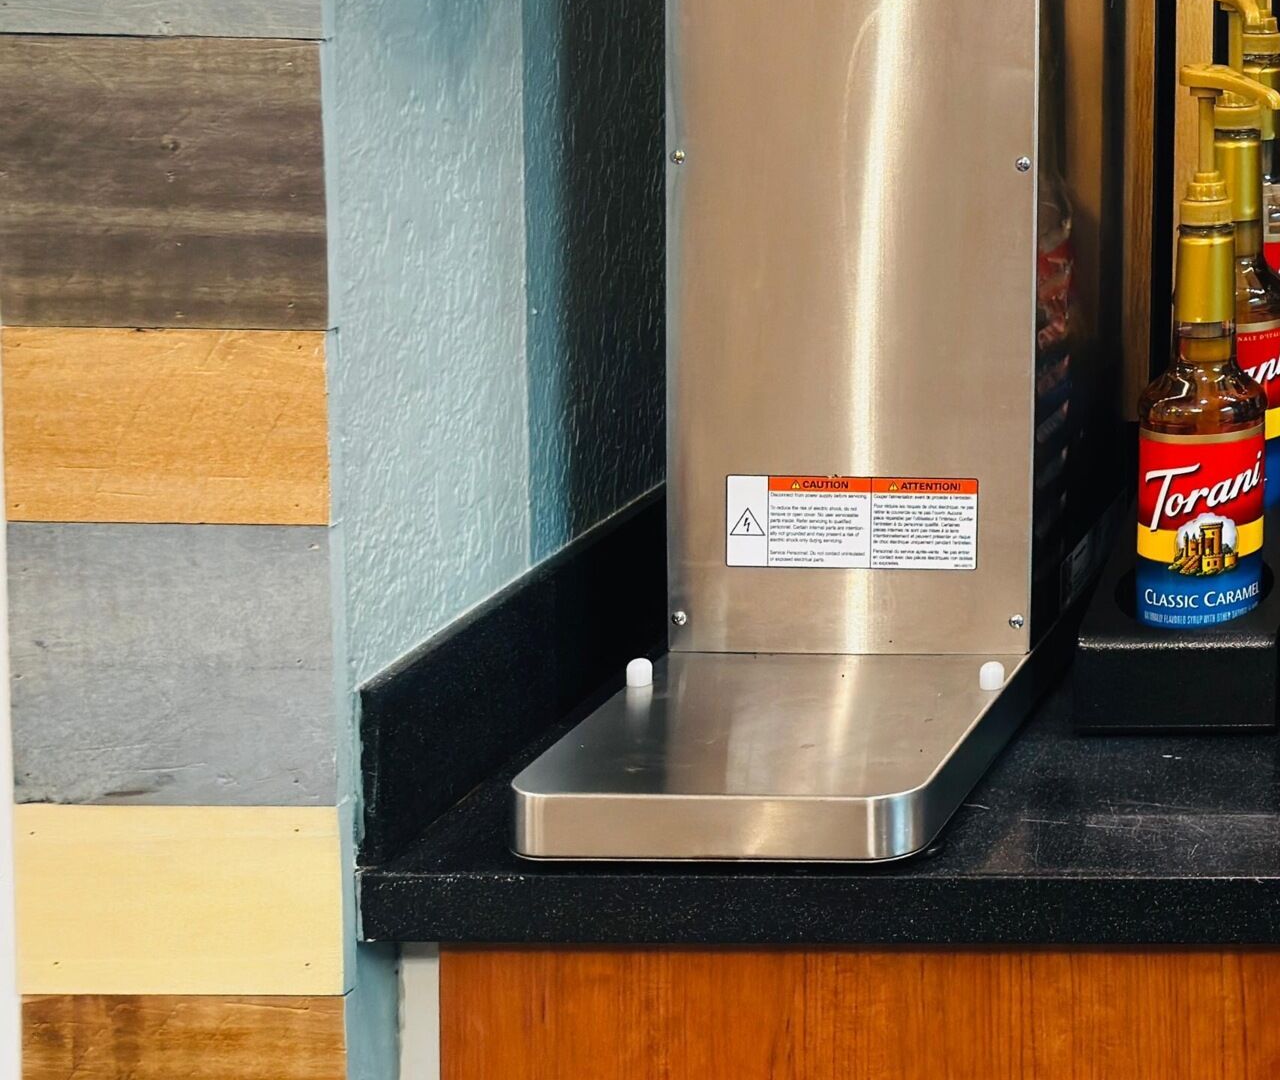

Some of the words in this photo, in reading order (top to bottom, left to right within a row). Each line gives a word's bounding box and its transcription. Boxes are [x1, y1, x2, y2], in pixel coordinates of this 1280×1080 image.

[802, 480, 849, 489] CAUTION
[901, 482, 961, 491] ATTENTION!
[1145, 450, 1261, 532] Torani
[1144, 588, 1199, 608] CLASSIC
[1204, 581, 1260, 607] CARAMEL
